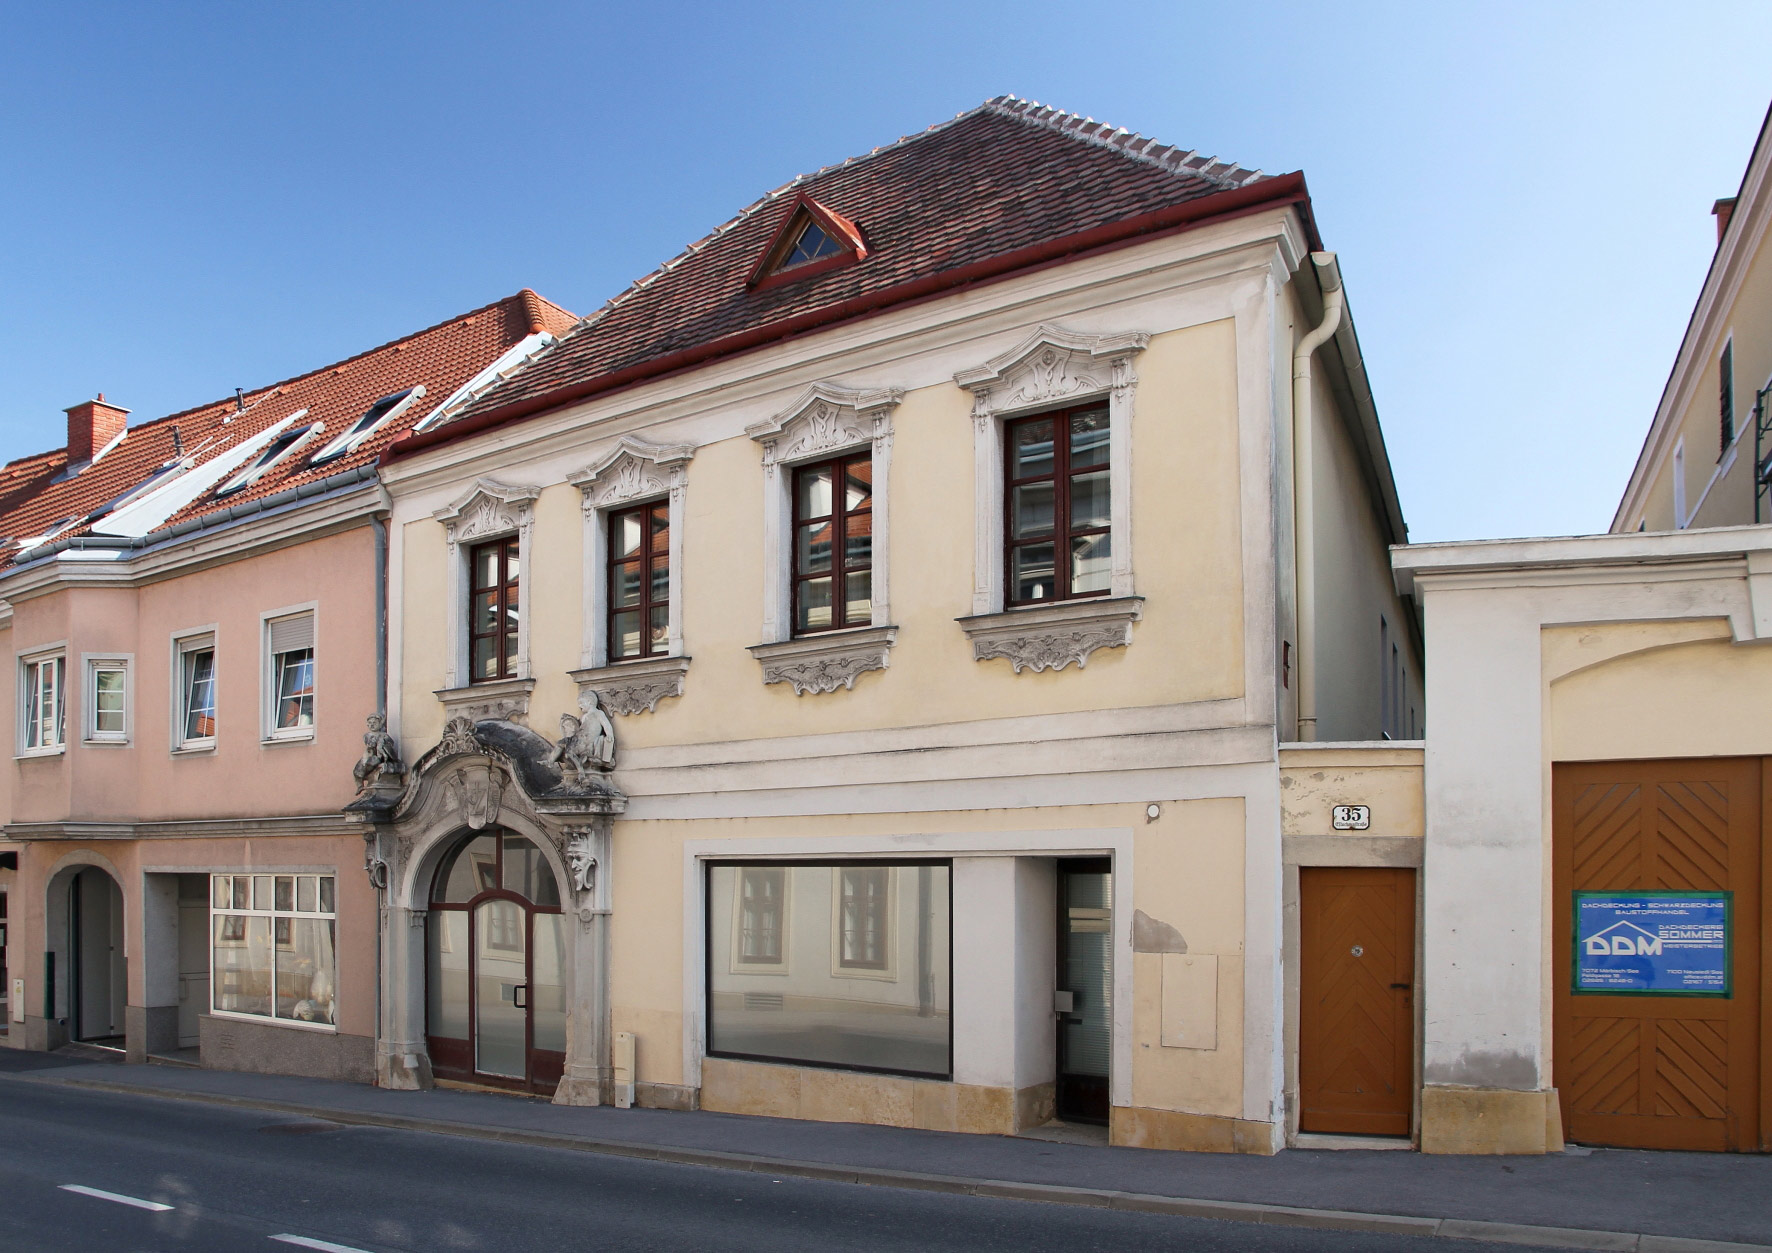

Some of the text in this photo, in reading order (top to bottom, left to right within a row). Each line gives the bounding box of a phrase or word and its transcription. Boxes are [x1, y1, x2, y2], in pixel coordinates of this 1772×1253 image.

[1341, 808, 1362, 821] 35
[1658, 930, 1724, 939] SOMMER
[1586, 936, 1663, 956] DDM
